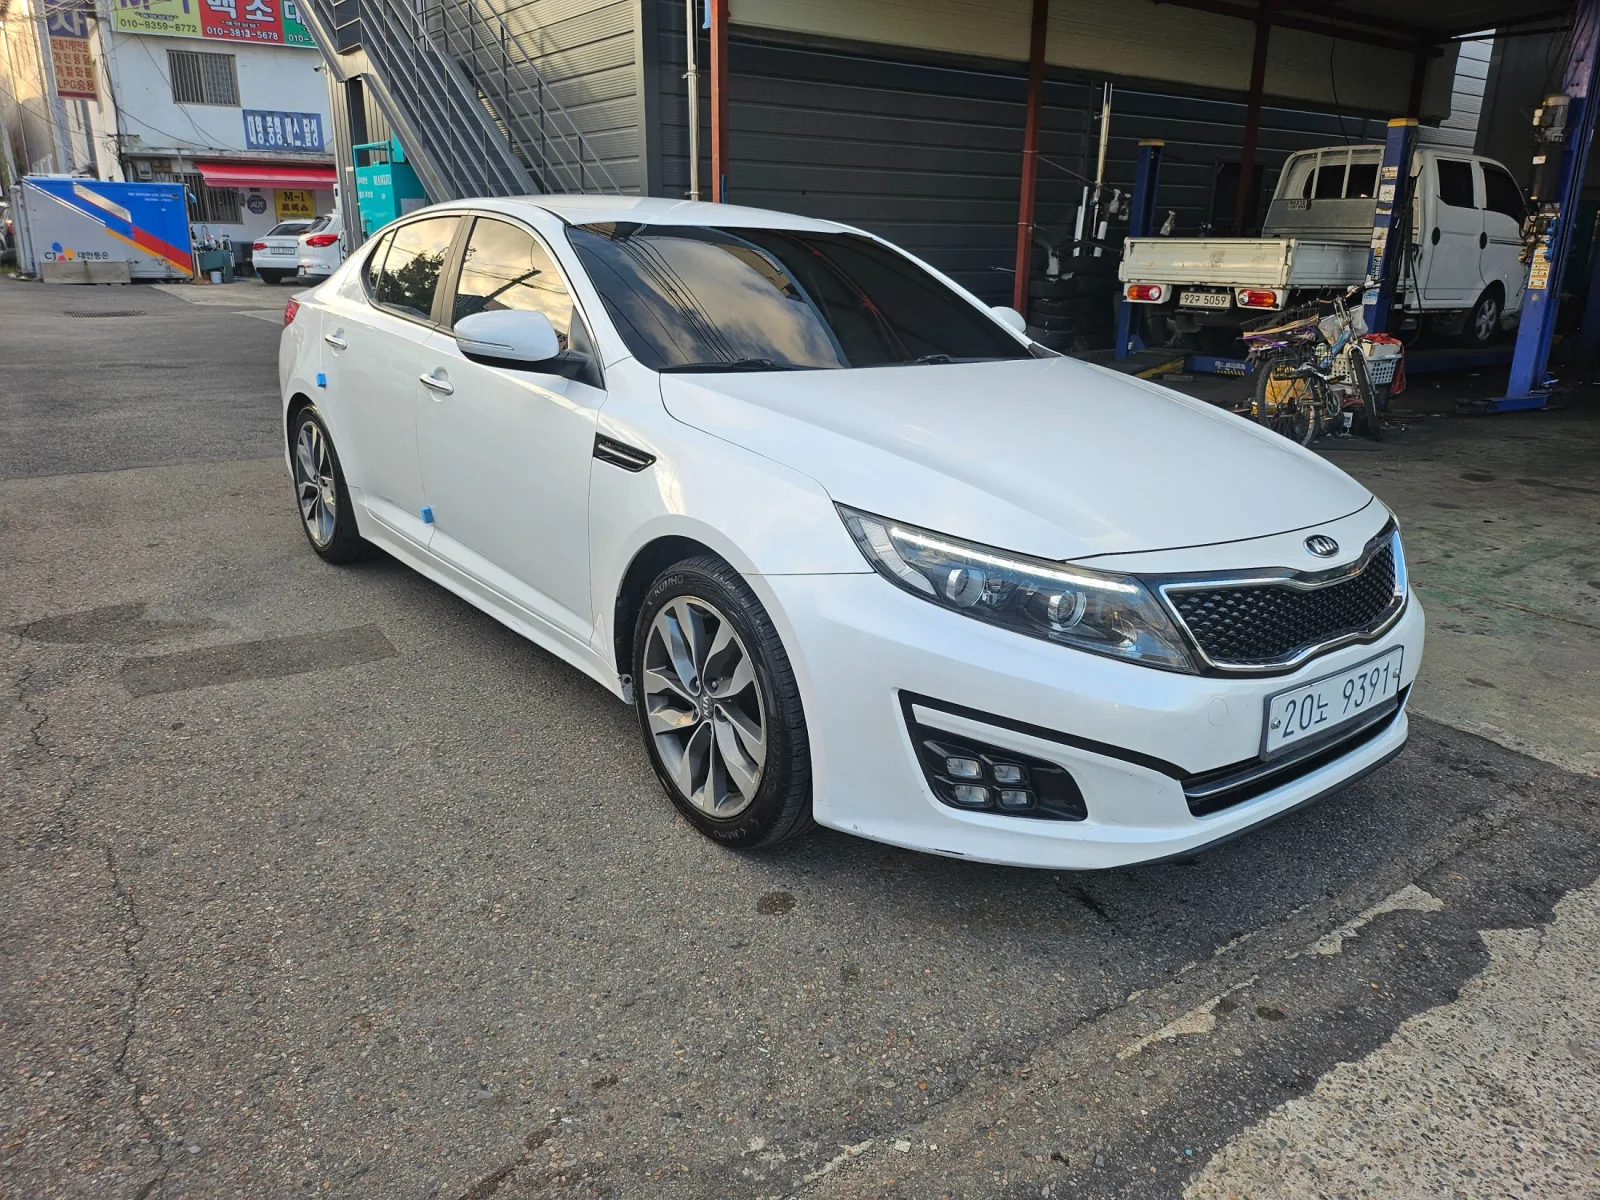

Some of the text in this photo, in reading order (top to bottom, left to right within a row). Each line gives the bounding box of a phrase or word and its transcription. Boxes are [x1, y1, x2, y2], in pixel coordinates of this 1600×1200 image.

[120, 19, 198, 33] 010-9359-8772
[206, 26, 279, 40] 010-3813-5678
[58, 80, 95, 91] LPG승용
[283, 191, 305, 202] M-1
[251, 201, 264, 209] ADT
[44, 251, 57, 262] CJ
[1203, 295, 1227, 306] 5059
[654, 574, 684, 597] KUMHO
[1282, 661, 1390, 738] 20노 9391
